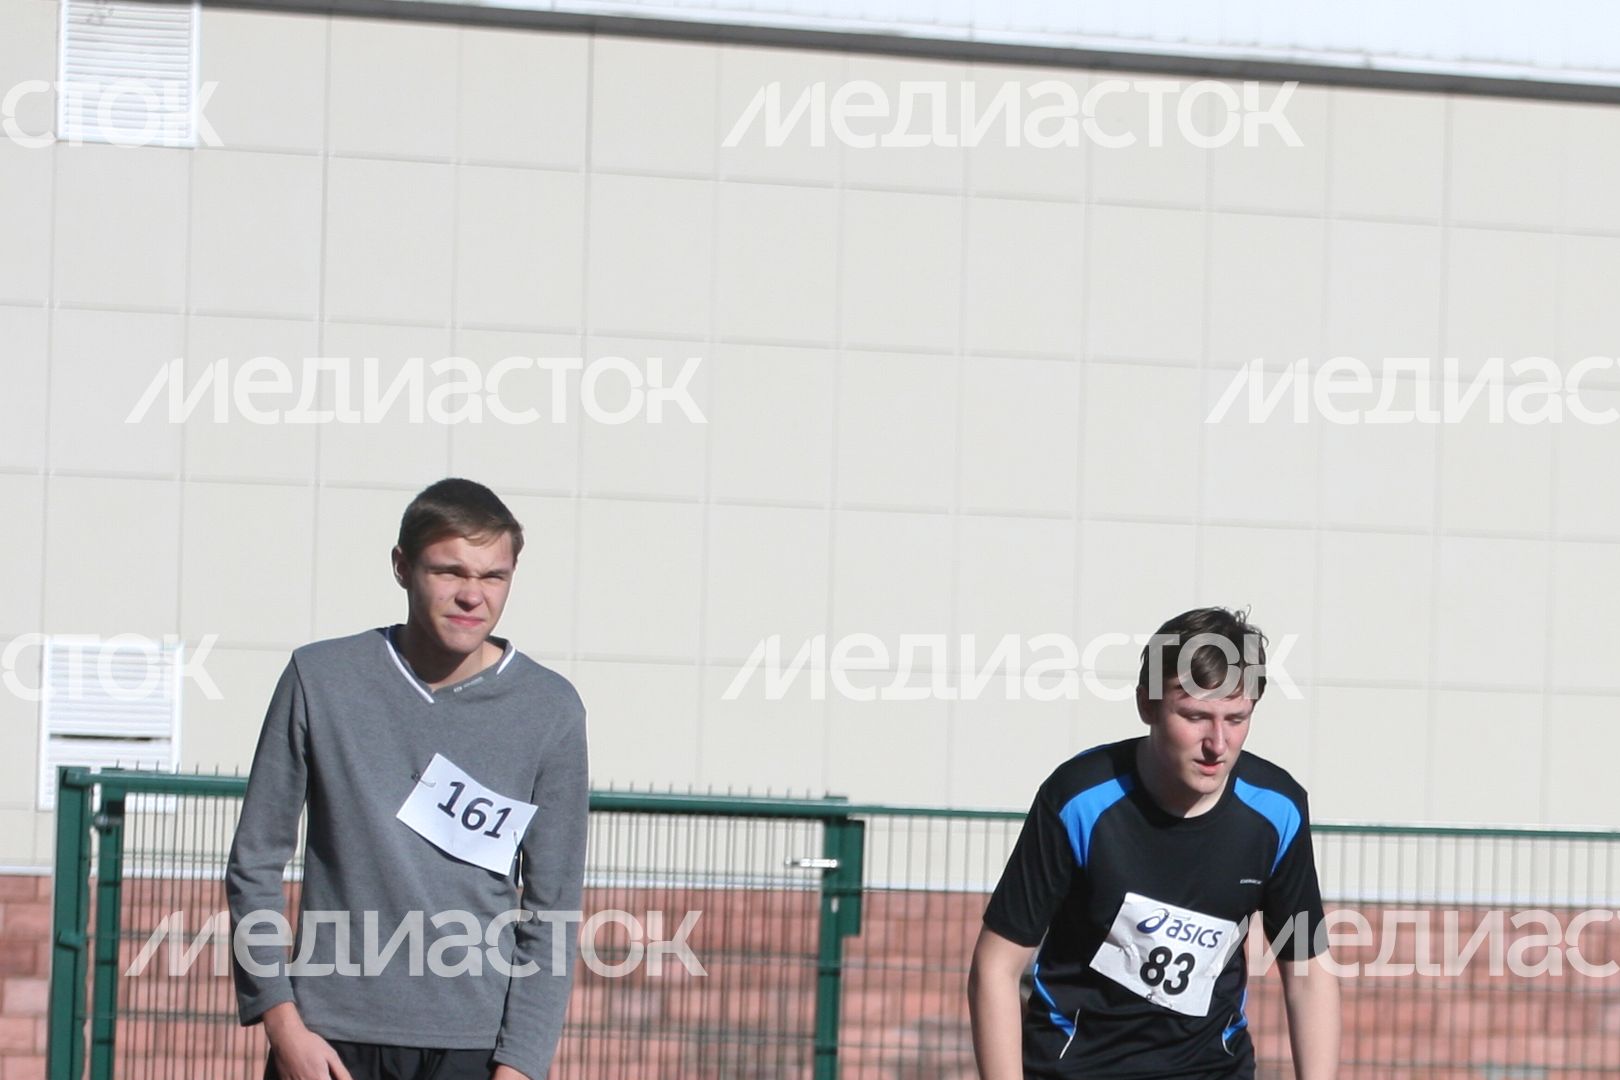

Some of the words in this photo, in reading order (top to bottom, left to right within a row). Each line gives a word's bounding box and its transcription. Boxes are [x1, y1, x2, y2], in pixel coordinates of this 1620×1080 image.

[437, 780, 513, 839] 161
[1165, 918, 1223, 949] asics
[1139, 945, 1196, 996] 83
